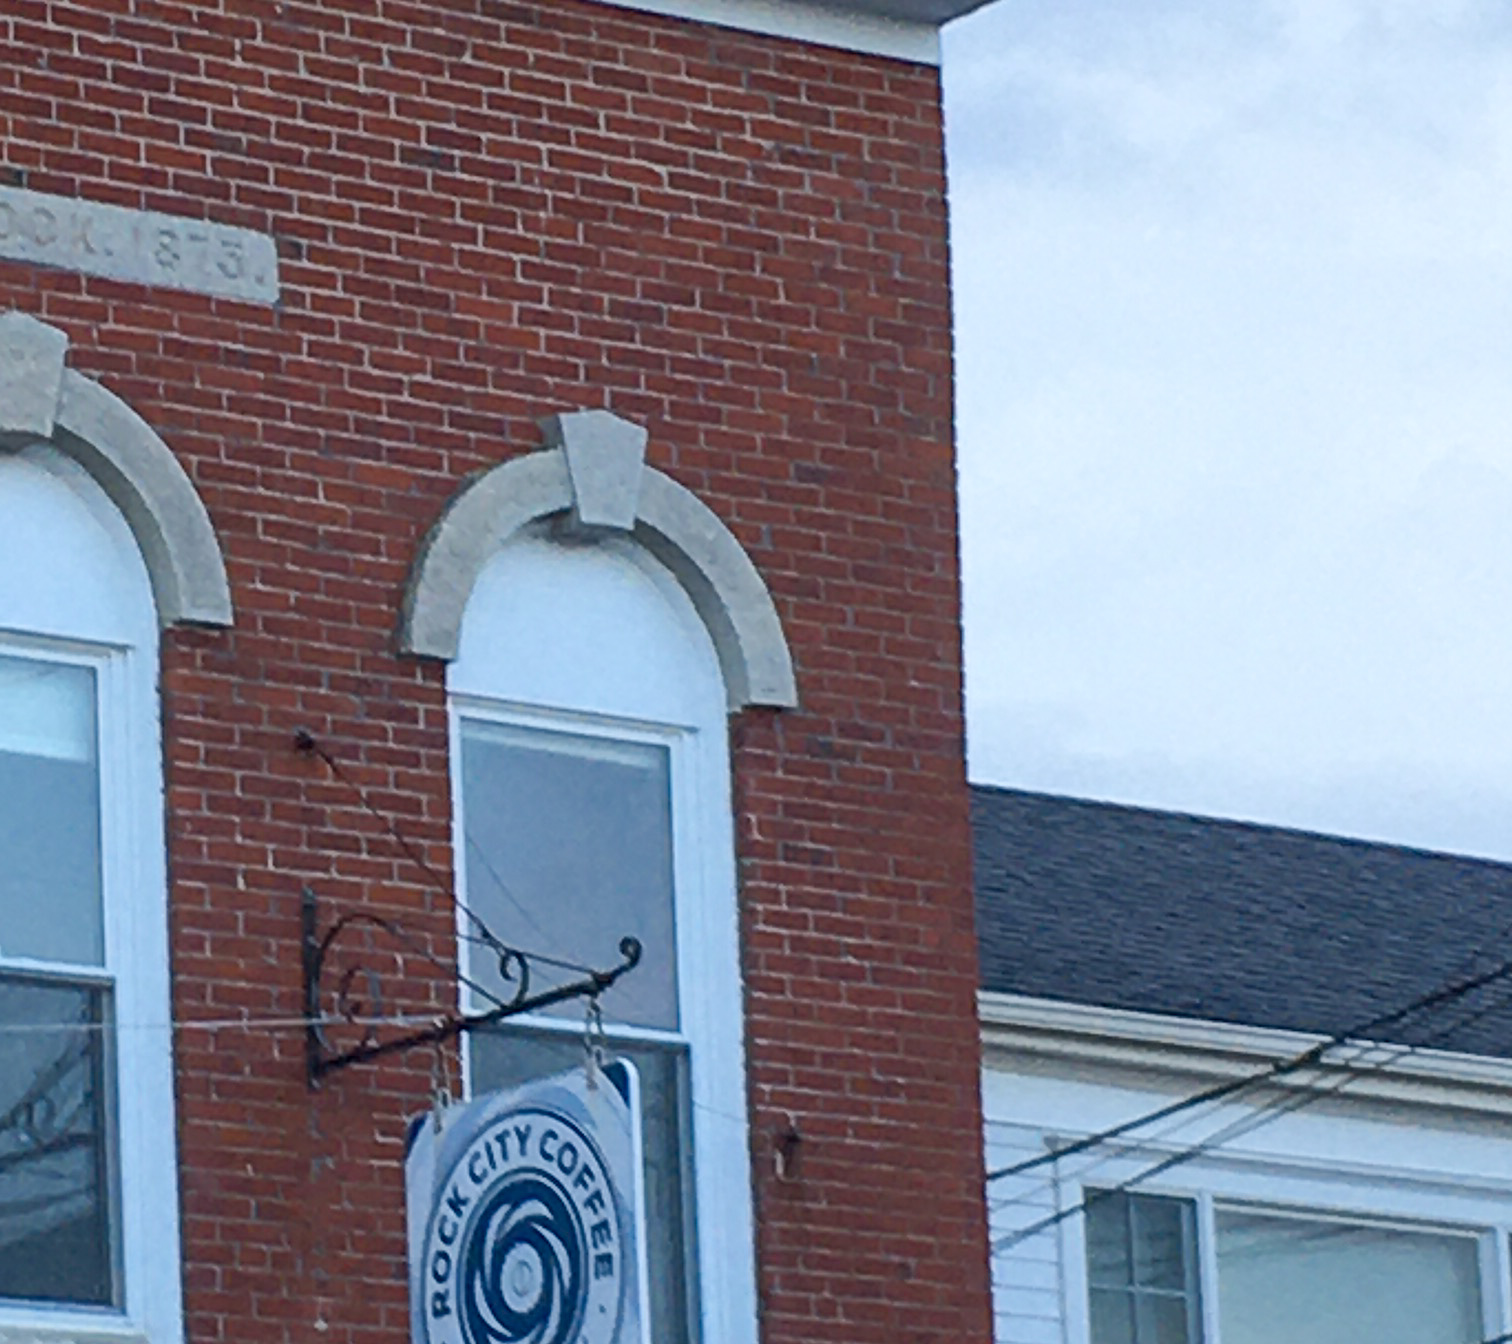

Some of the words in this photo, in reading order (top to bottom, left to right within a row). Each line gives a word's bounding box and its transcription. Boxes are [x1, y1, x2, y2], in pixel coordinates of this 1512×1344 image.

[431, 1184, 471, 1320] ROCK
[467, 1124, 533, 1188] CITY
[538, 1128, 615, 1282] COFFEE
